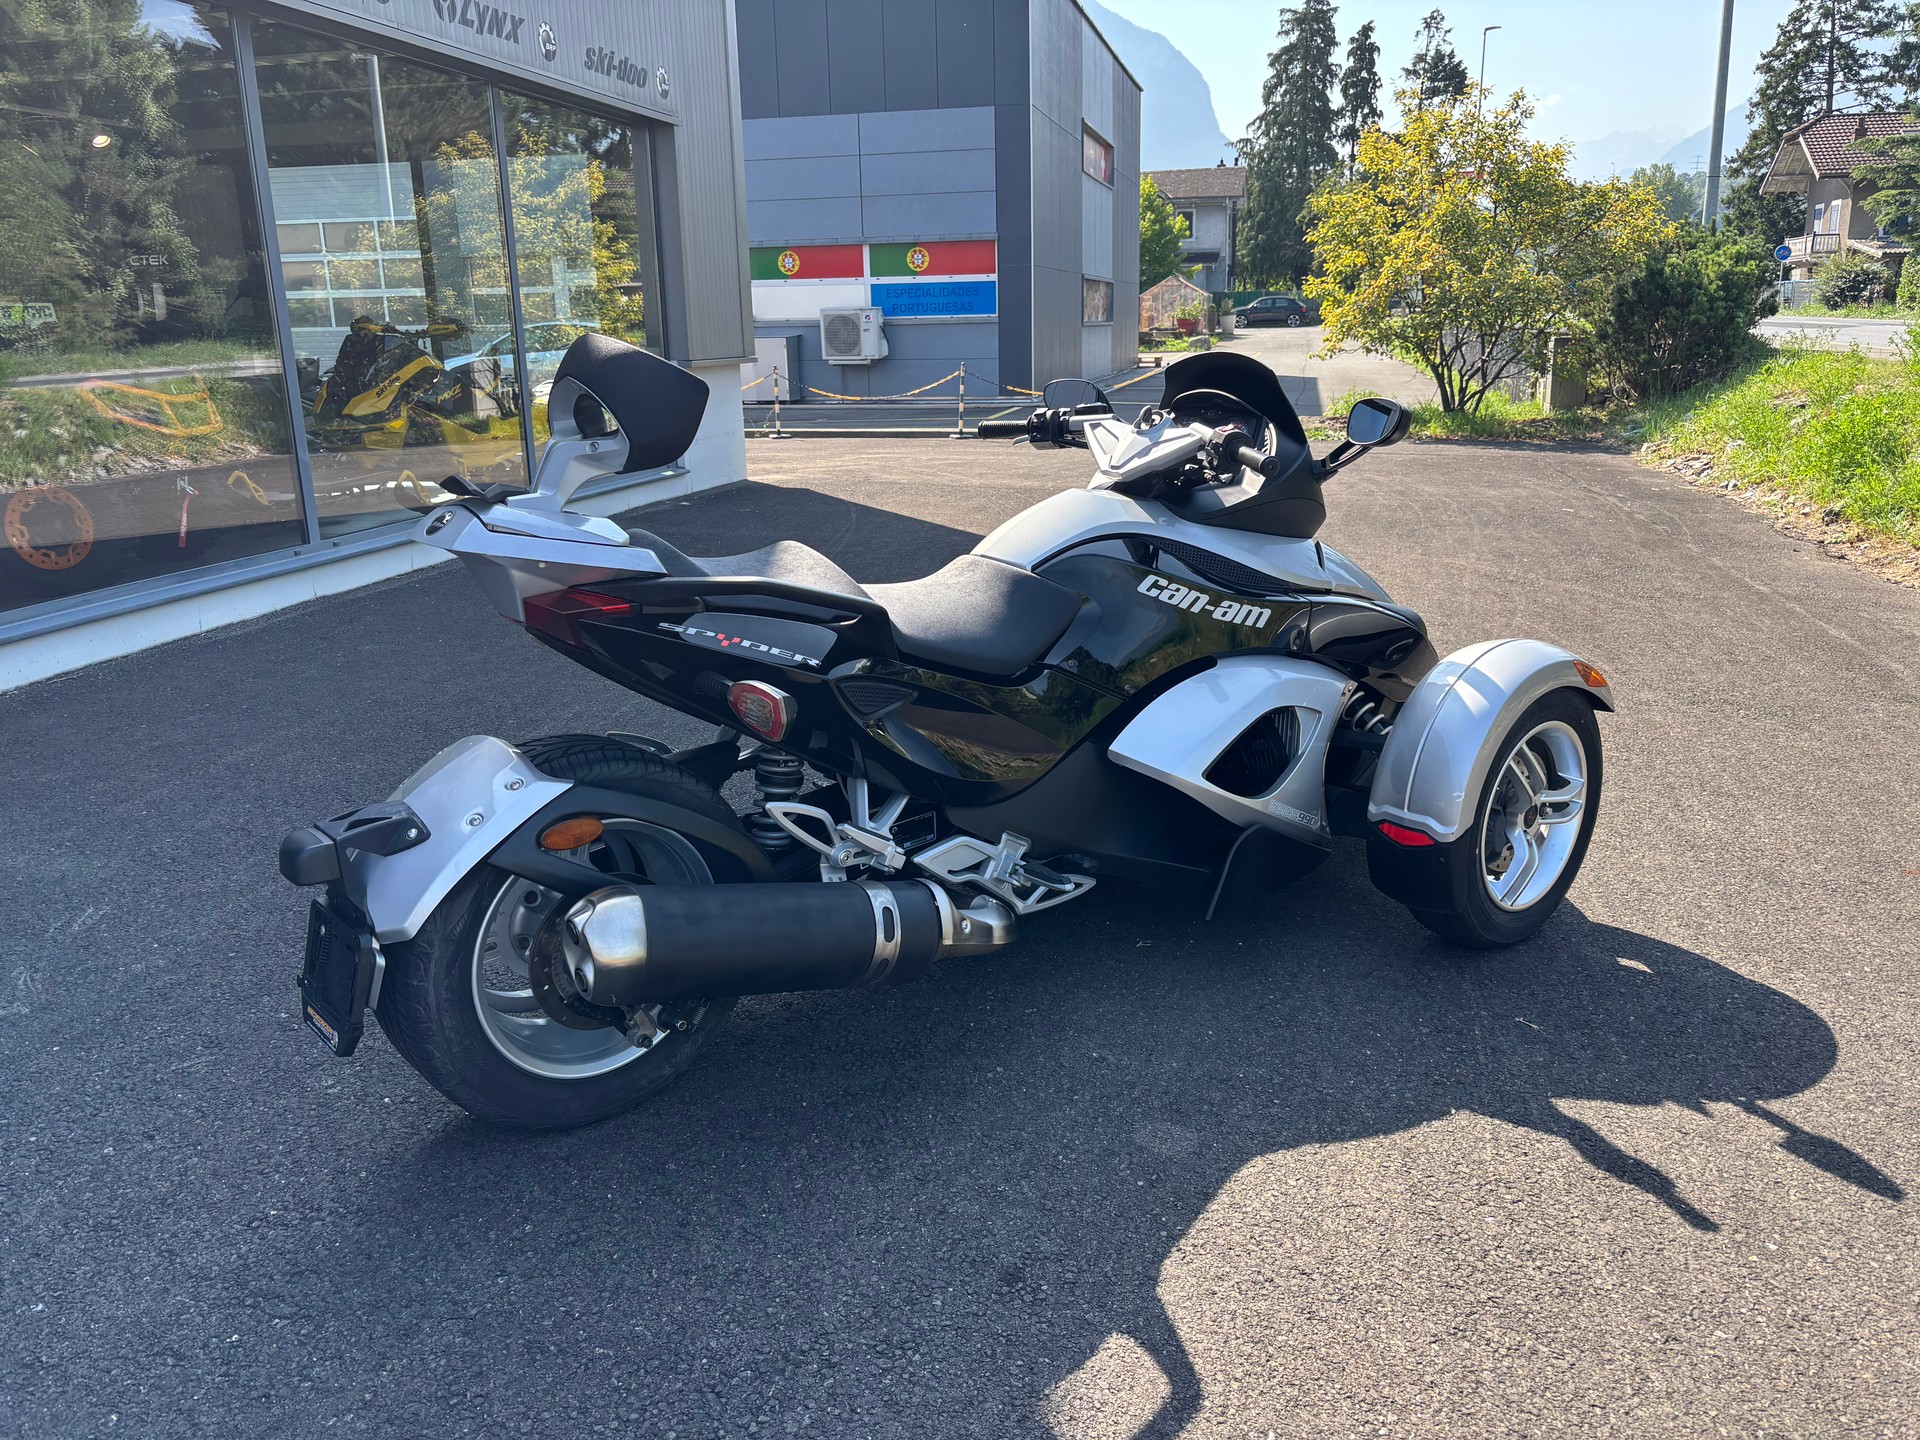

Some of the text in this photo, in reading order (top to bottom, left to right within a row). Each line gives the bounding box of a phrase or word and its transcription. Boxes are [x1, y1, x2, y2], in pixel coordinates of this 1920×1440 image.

[130, 254, 169, 266] CTEK
[886, 286, 980, 299] ESPECIALIDADES
[892, 301, 974, 314] PORTUGUESAS
[1137, 574, 1272, 628] can-am
[657, 622, 822, 668] SPYDER
